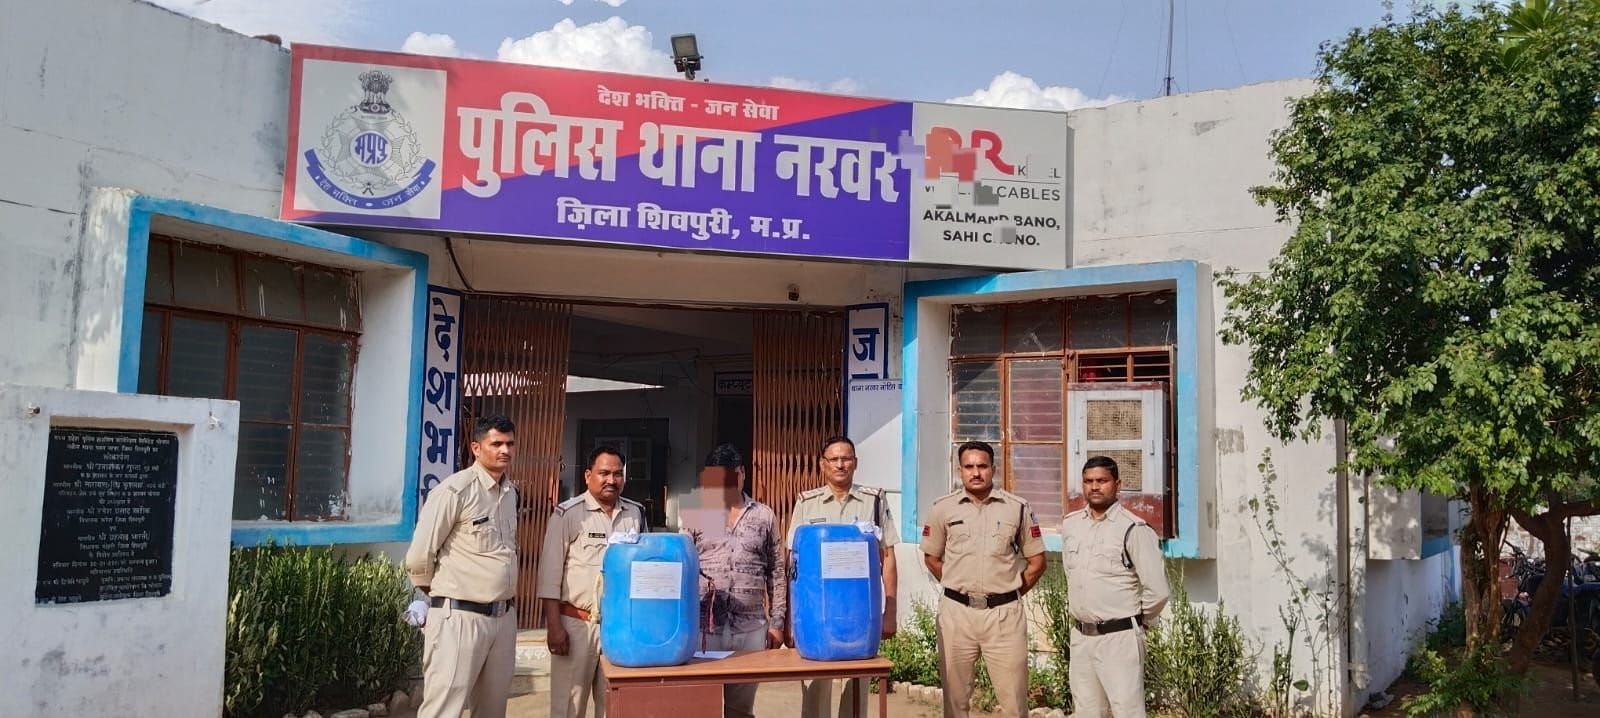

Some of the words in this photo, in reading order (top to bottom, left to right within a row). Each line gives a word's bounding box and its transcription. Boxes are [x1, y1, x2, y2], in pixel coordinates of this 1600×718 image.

[598, 84, 629, 107] देश
[635, 89, 686, 113] भक्ति
[705, 98, 739, 117] जन
[742, 98, 780, 121] सेवा
[457, 92, 624, 198] पुलिस
[638, 121, 763, 192] थाना
[774, 134, 900, 203] नरवर
[996, 186, 1061, 201] CABLES
[1014, 215, 1061, 231] BANO,
[943, 230, 978, 242] SAHI
[983, 233, 1041, 246] CNO.
